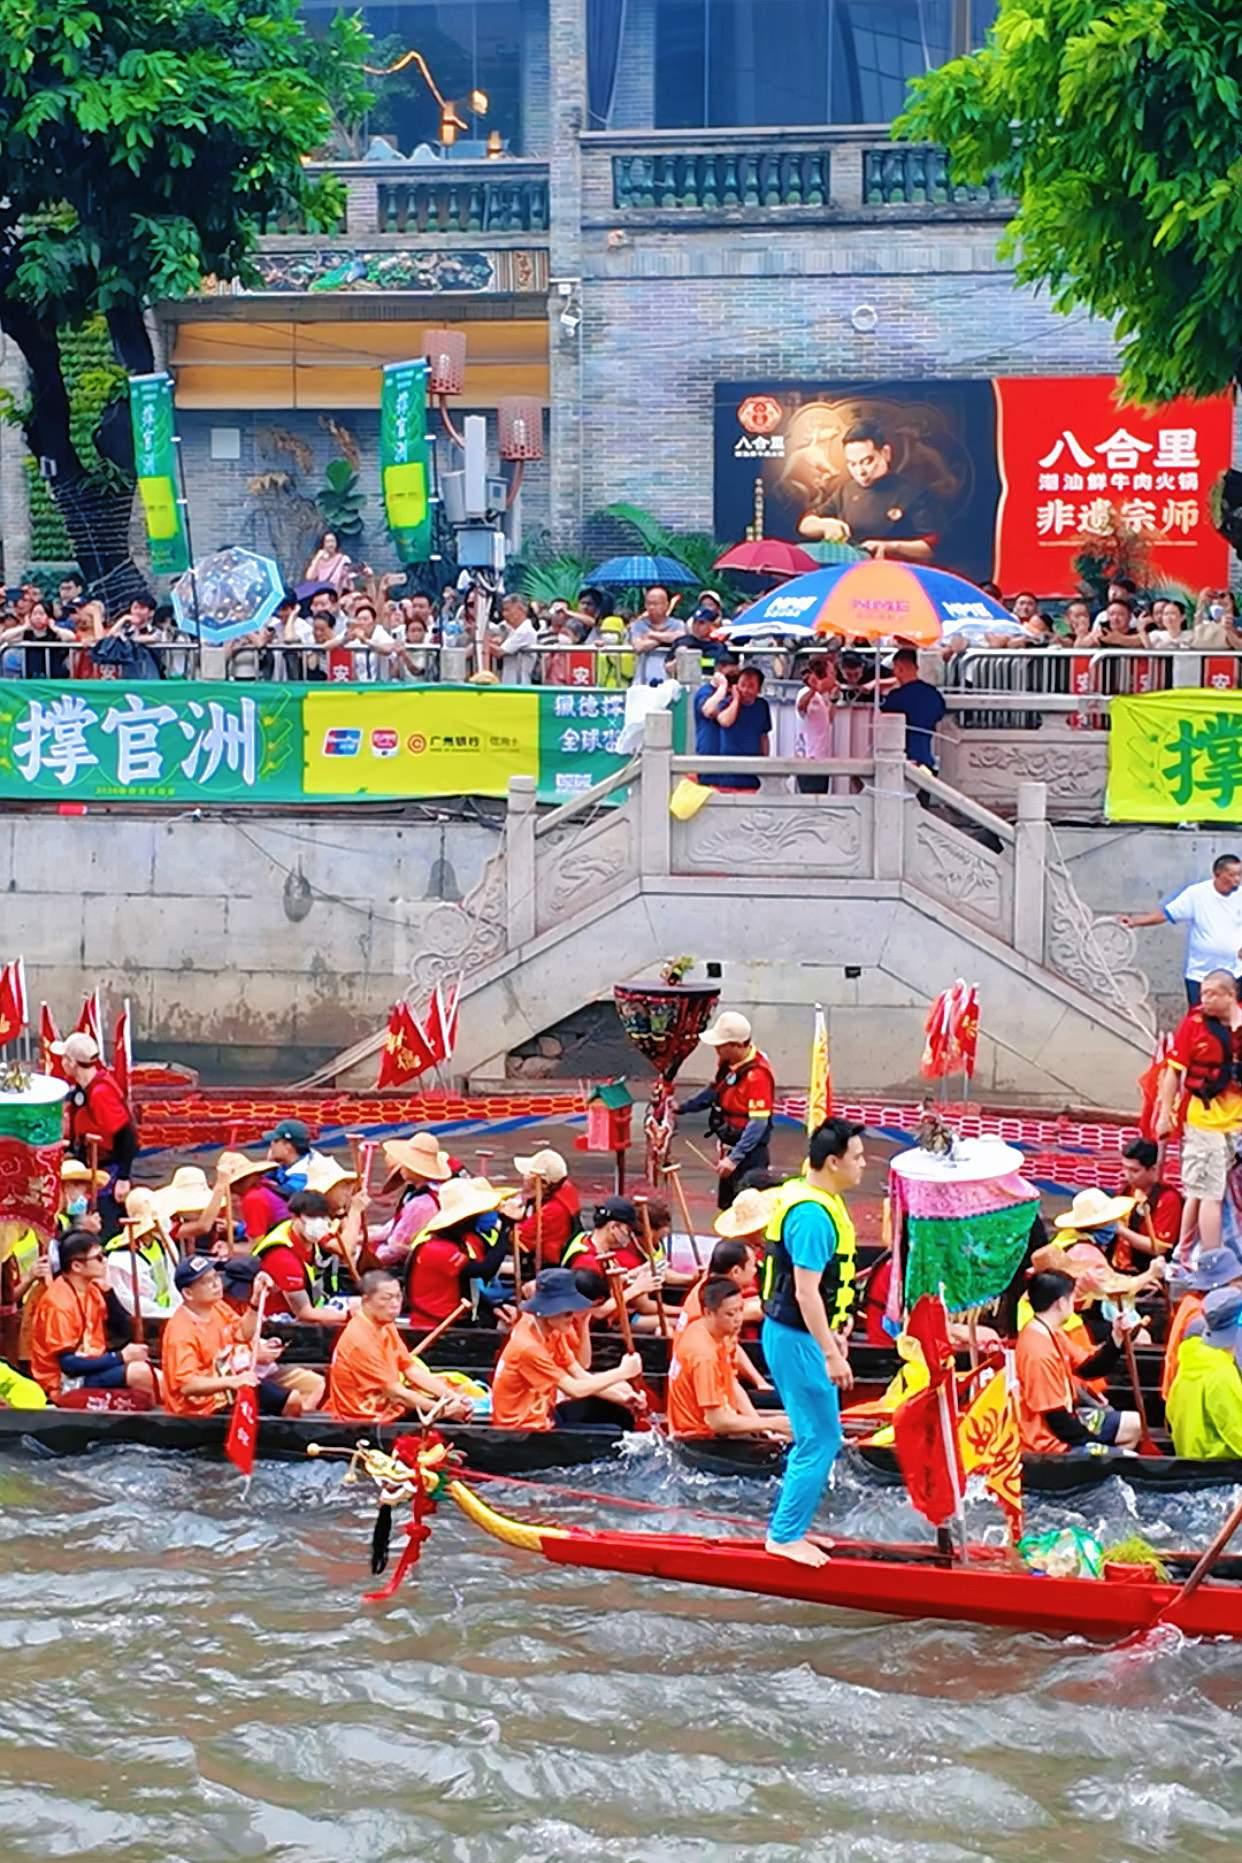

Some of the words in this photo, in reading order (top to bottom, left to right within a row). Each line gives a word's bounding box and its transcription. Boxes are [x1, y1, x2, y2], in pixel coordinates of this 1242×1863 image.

[734, 435, 785, 450] 八合里
[1038, 427, 1201, 469] 八合里
[1038, 472, 1199, 491] 潮汕鲜牛肉火锅
[1036, 497, 1199, 537] 非遗宗师
[12, 693, 257, 785] 撑官洲
